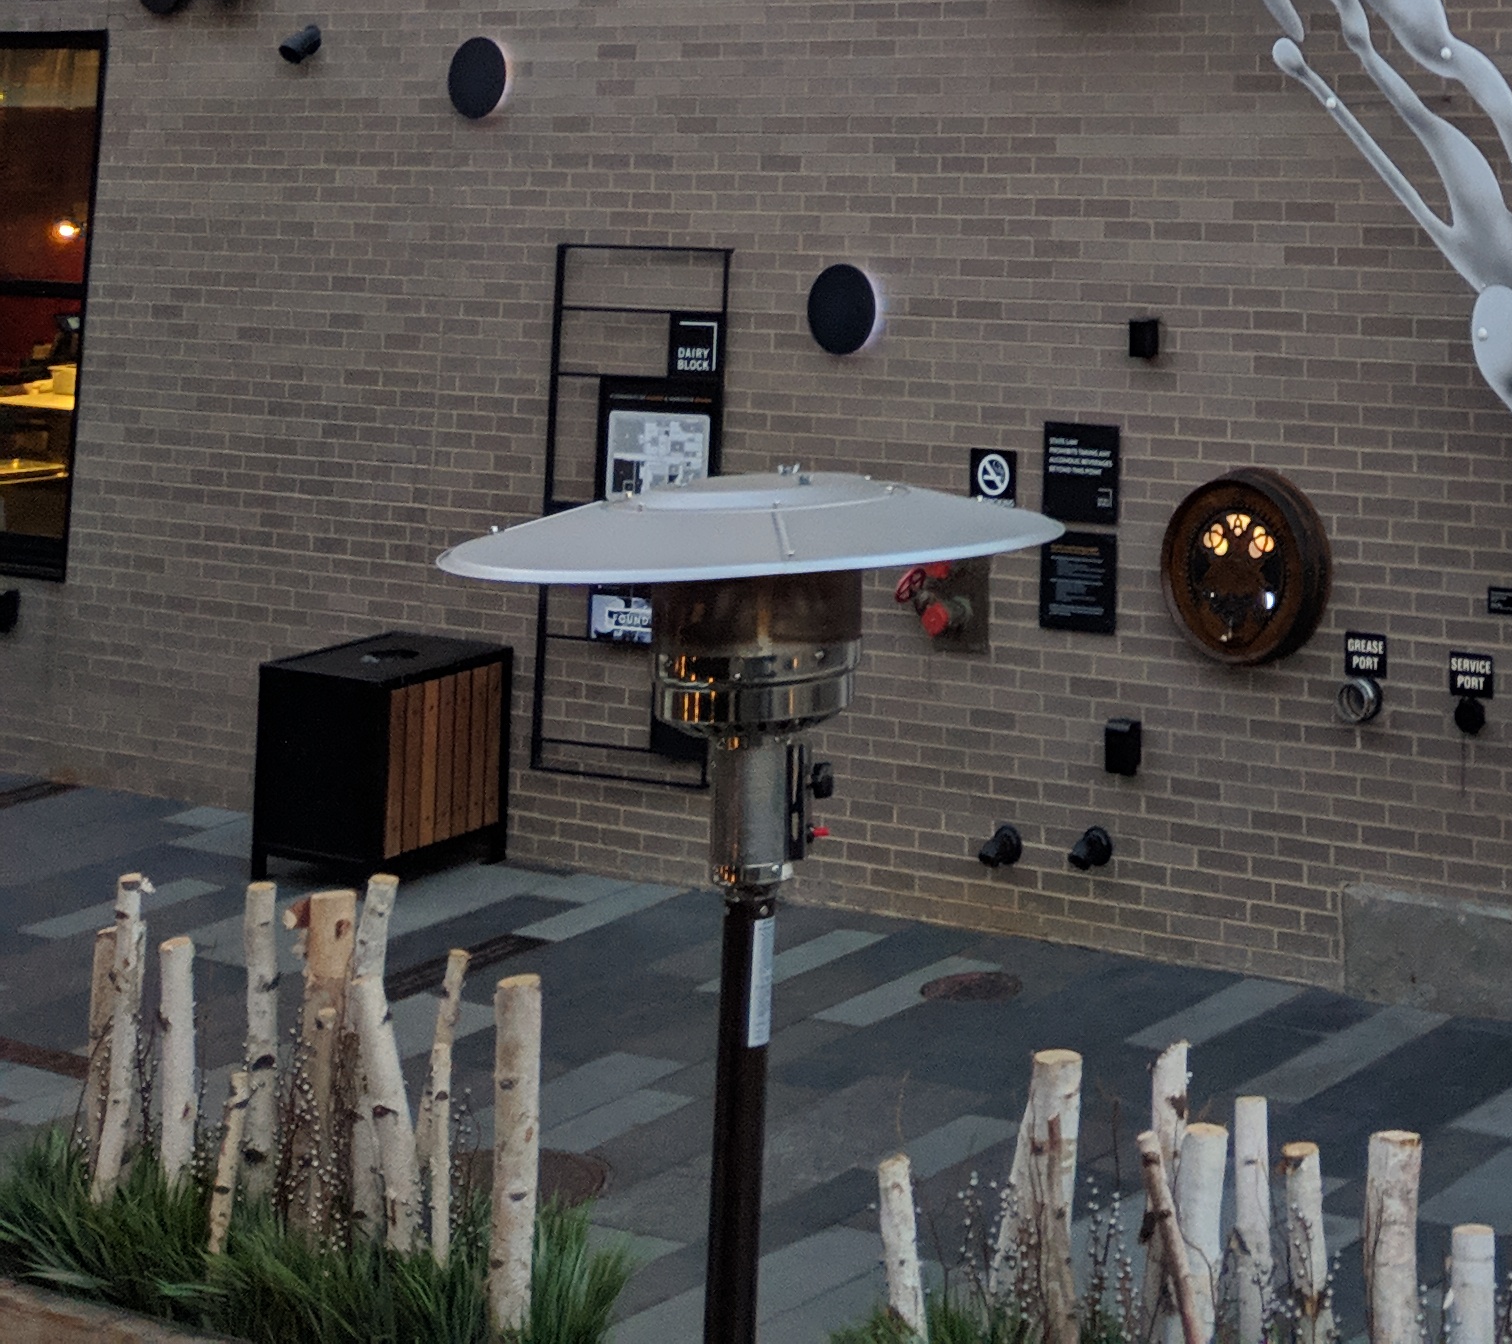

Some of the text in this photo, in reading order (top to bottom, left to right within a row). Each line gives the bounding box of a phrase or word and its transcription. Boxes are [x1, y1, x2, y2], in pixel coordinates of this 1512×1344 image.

[677, 346, 711, 359] DAIRY
[676, 359, 711, 372] BLOCK
[612, 613, 652, 626] FOUND
[1347, 639, 1384, 655] GREASE
[1352, 655, 1379, 671] PORT
[1450, 657, 1491, 674] SERVICE
[1456, 674, 1485, 691] PORT
